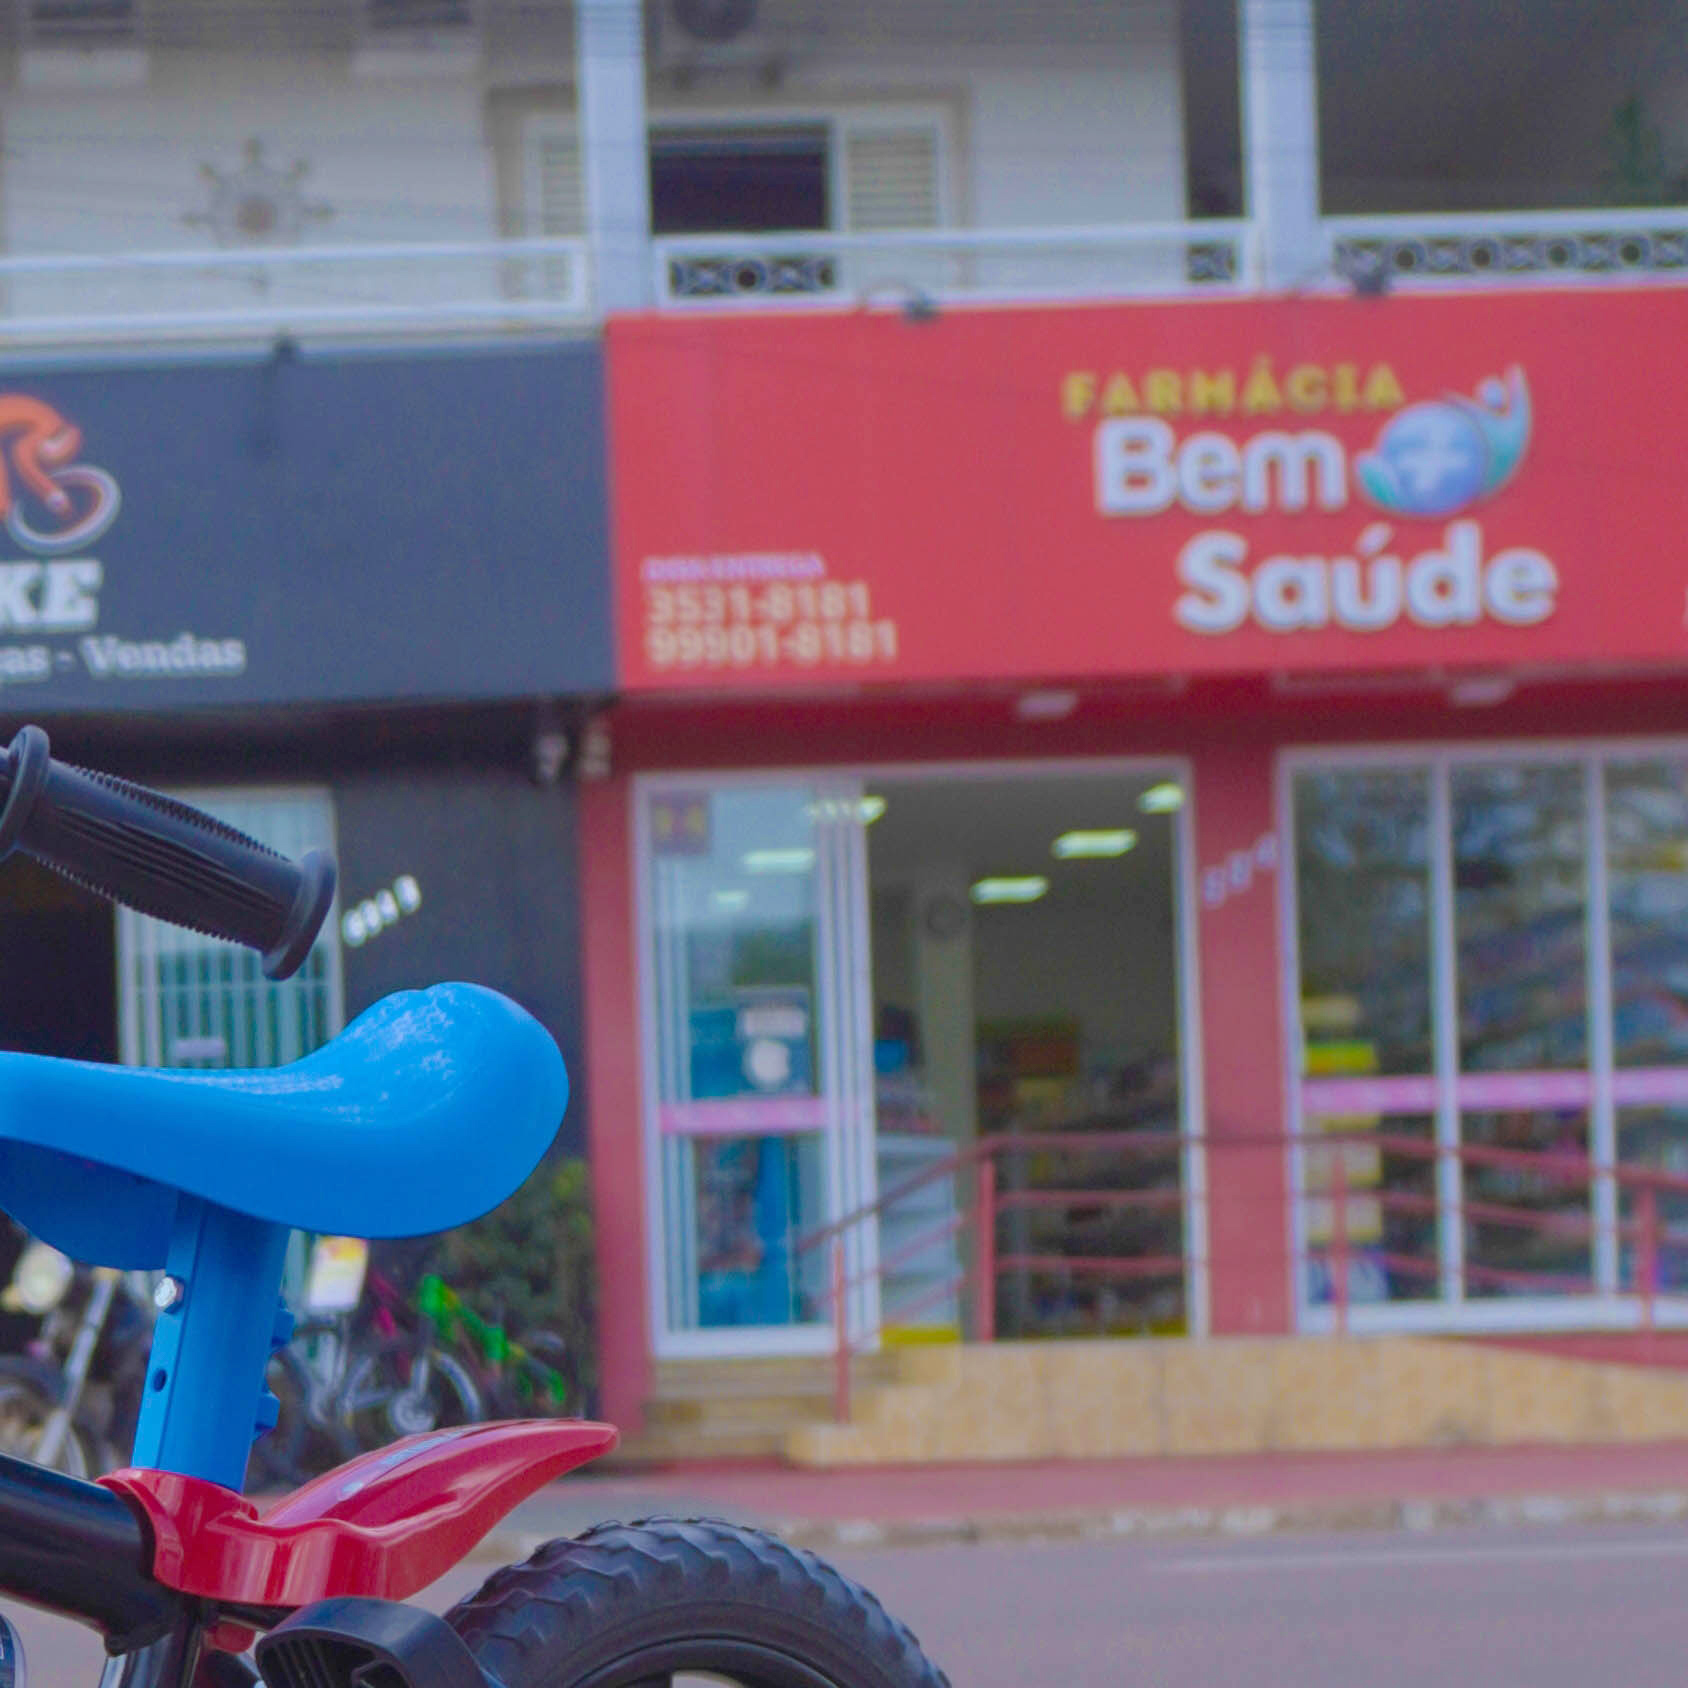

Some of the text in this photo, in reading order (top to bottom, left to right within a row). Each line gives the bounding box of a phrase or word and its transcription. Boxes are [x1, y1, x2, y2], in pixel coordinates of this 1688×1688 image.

[1062, 355, 1405, 417] FARMÁCIA
[1094, 416, 1348, 516] Bem
[1172, 520, 1559, 635] Saúde
[80, 634, 247, 678] Vendas
